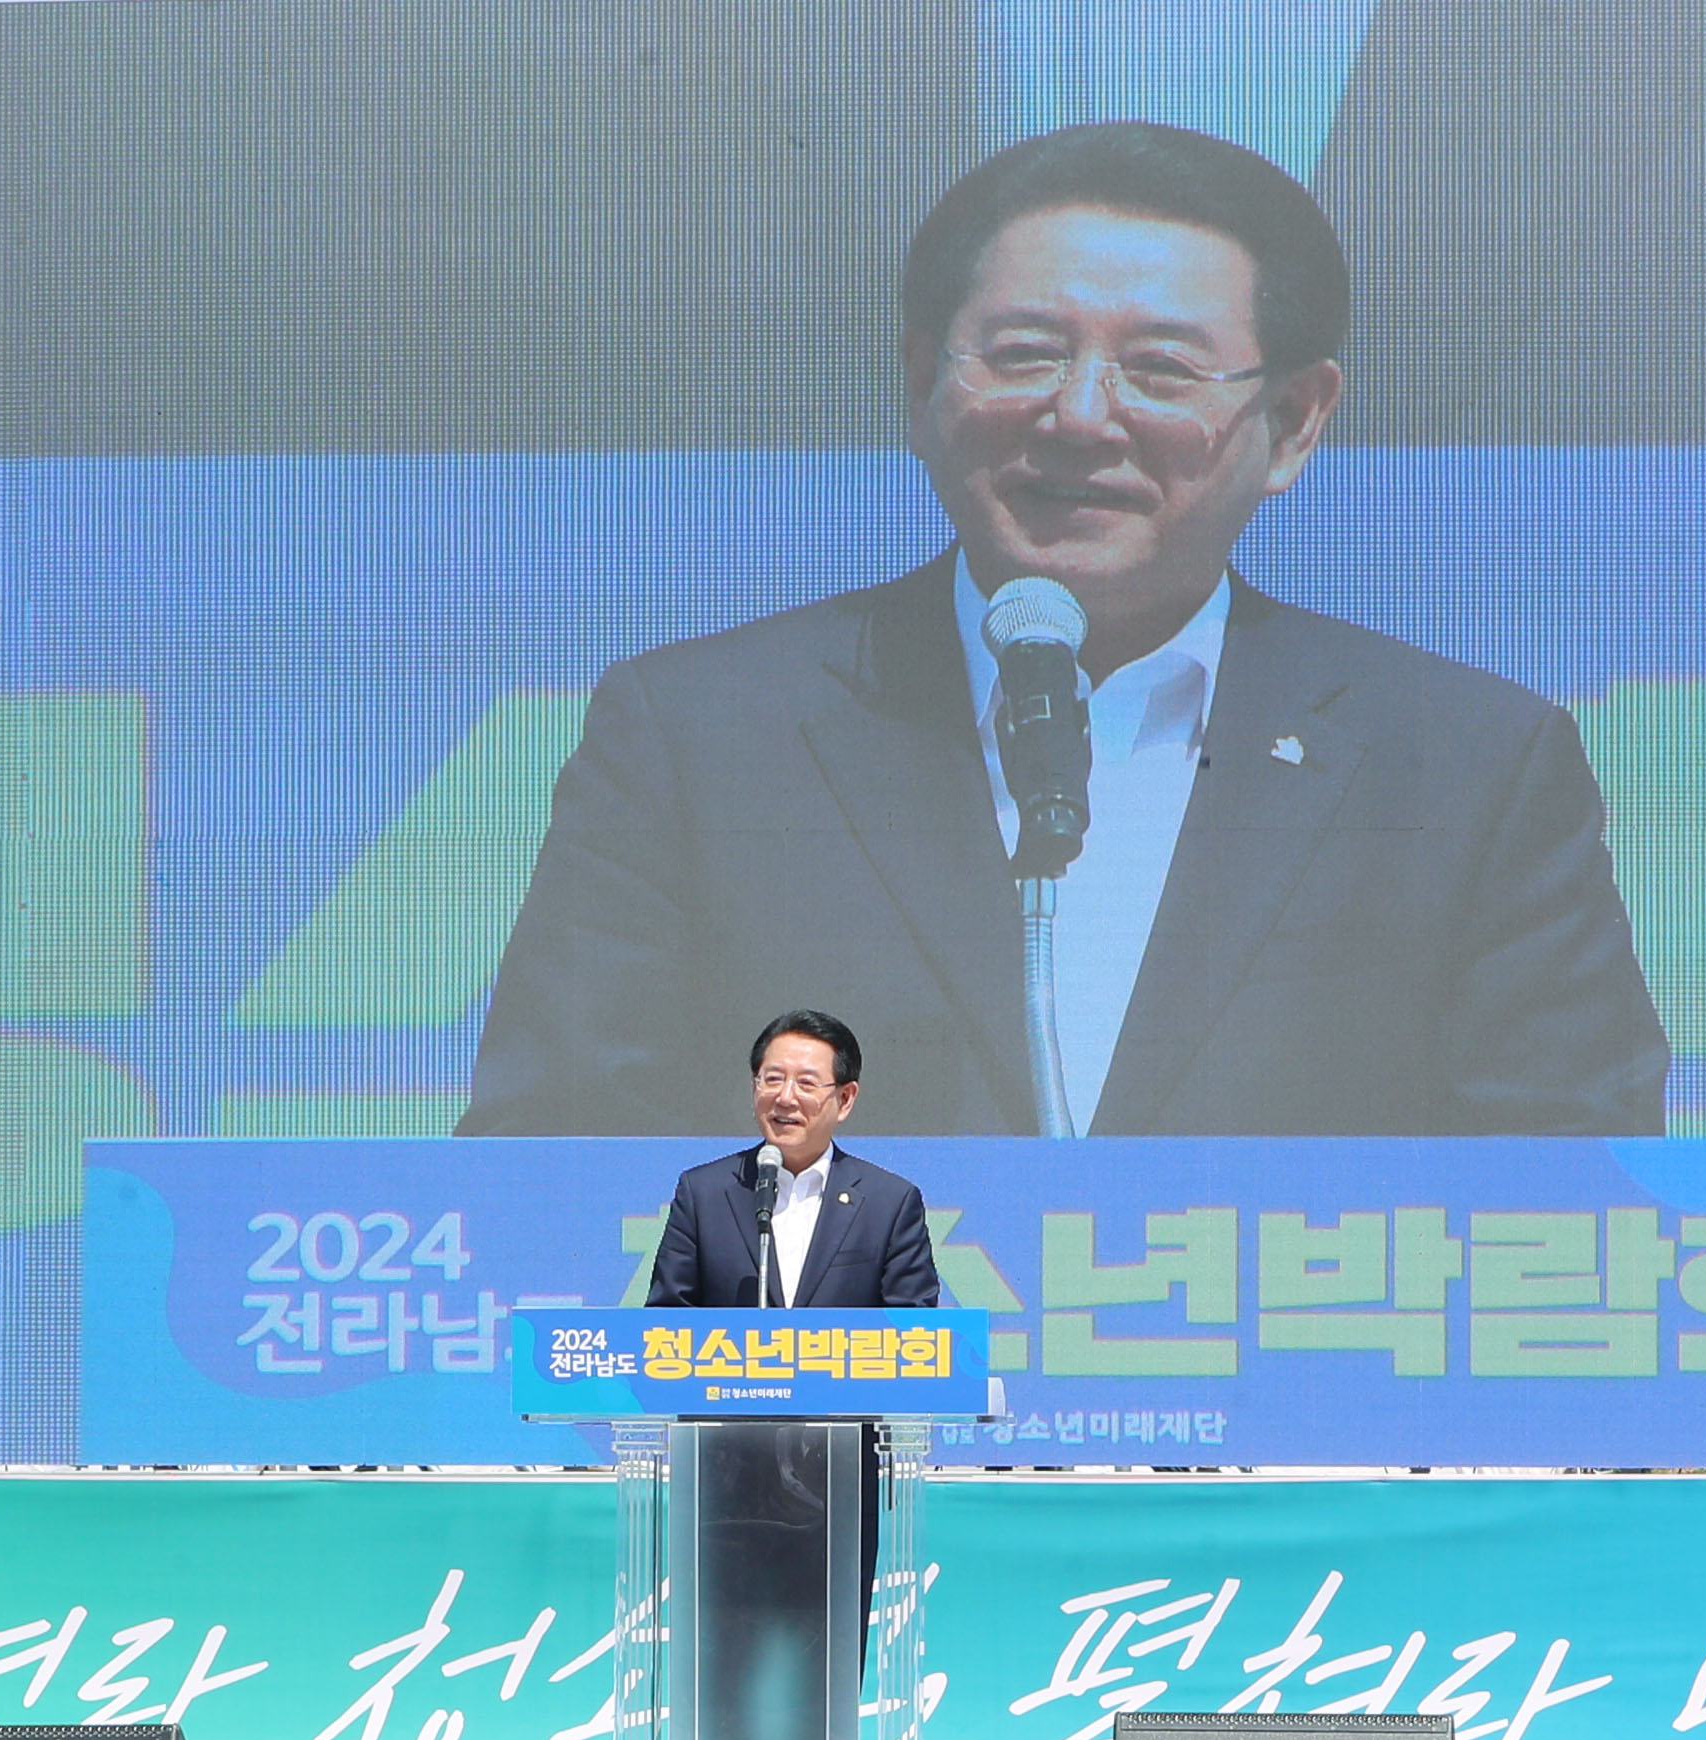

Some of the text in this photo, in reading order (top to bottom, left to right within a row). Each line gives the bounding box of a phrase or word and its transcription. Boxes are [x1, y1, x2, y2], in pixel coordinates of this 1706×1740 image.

[245, 1210, 472, 1283] 2024
[236, 1290, 584, 1375] 전라남
[550, 1328, 608, 1351] 2024
[642, 1326, 952, 1380] 청소년박람회
[548, 1352, 639, 1379] 전라남도
